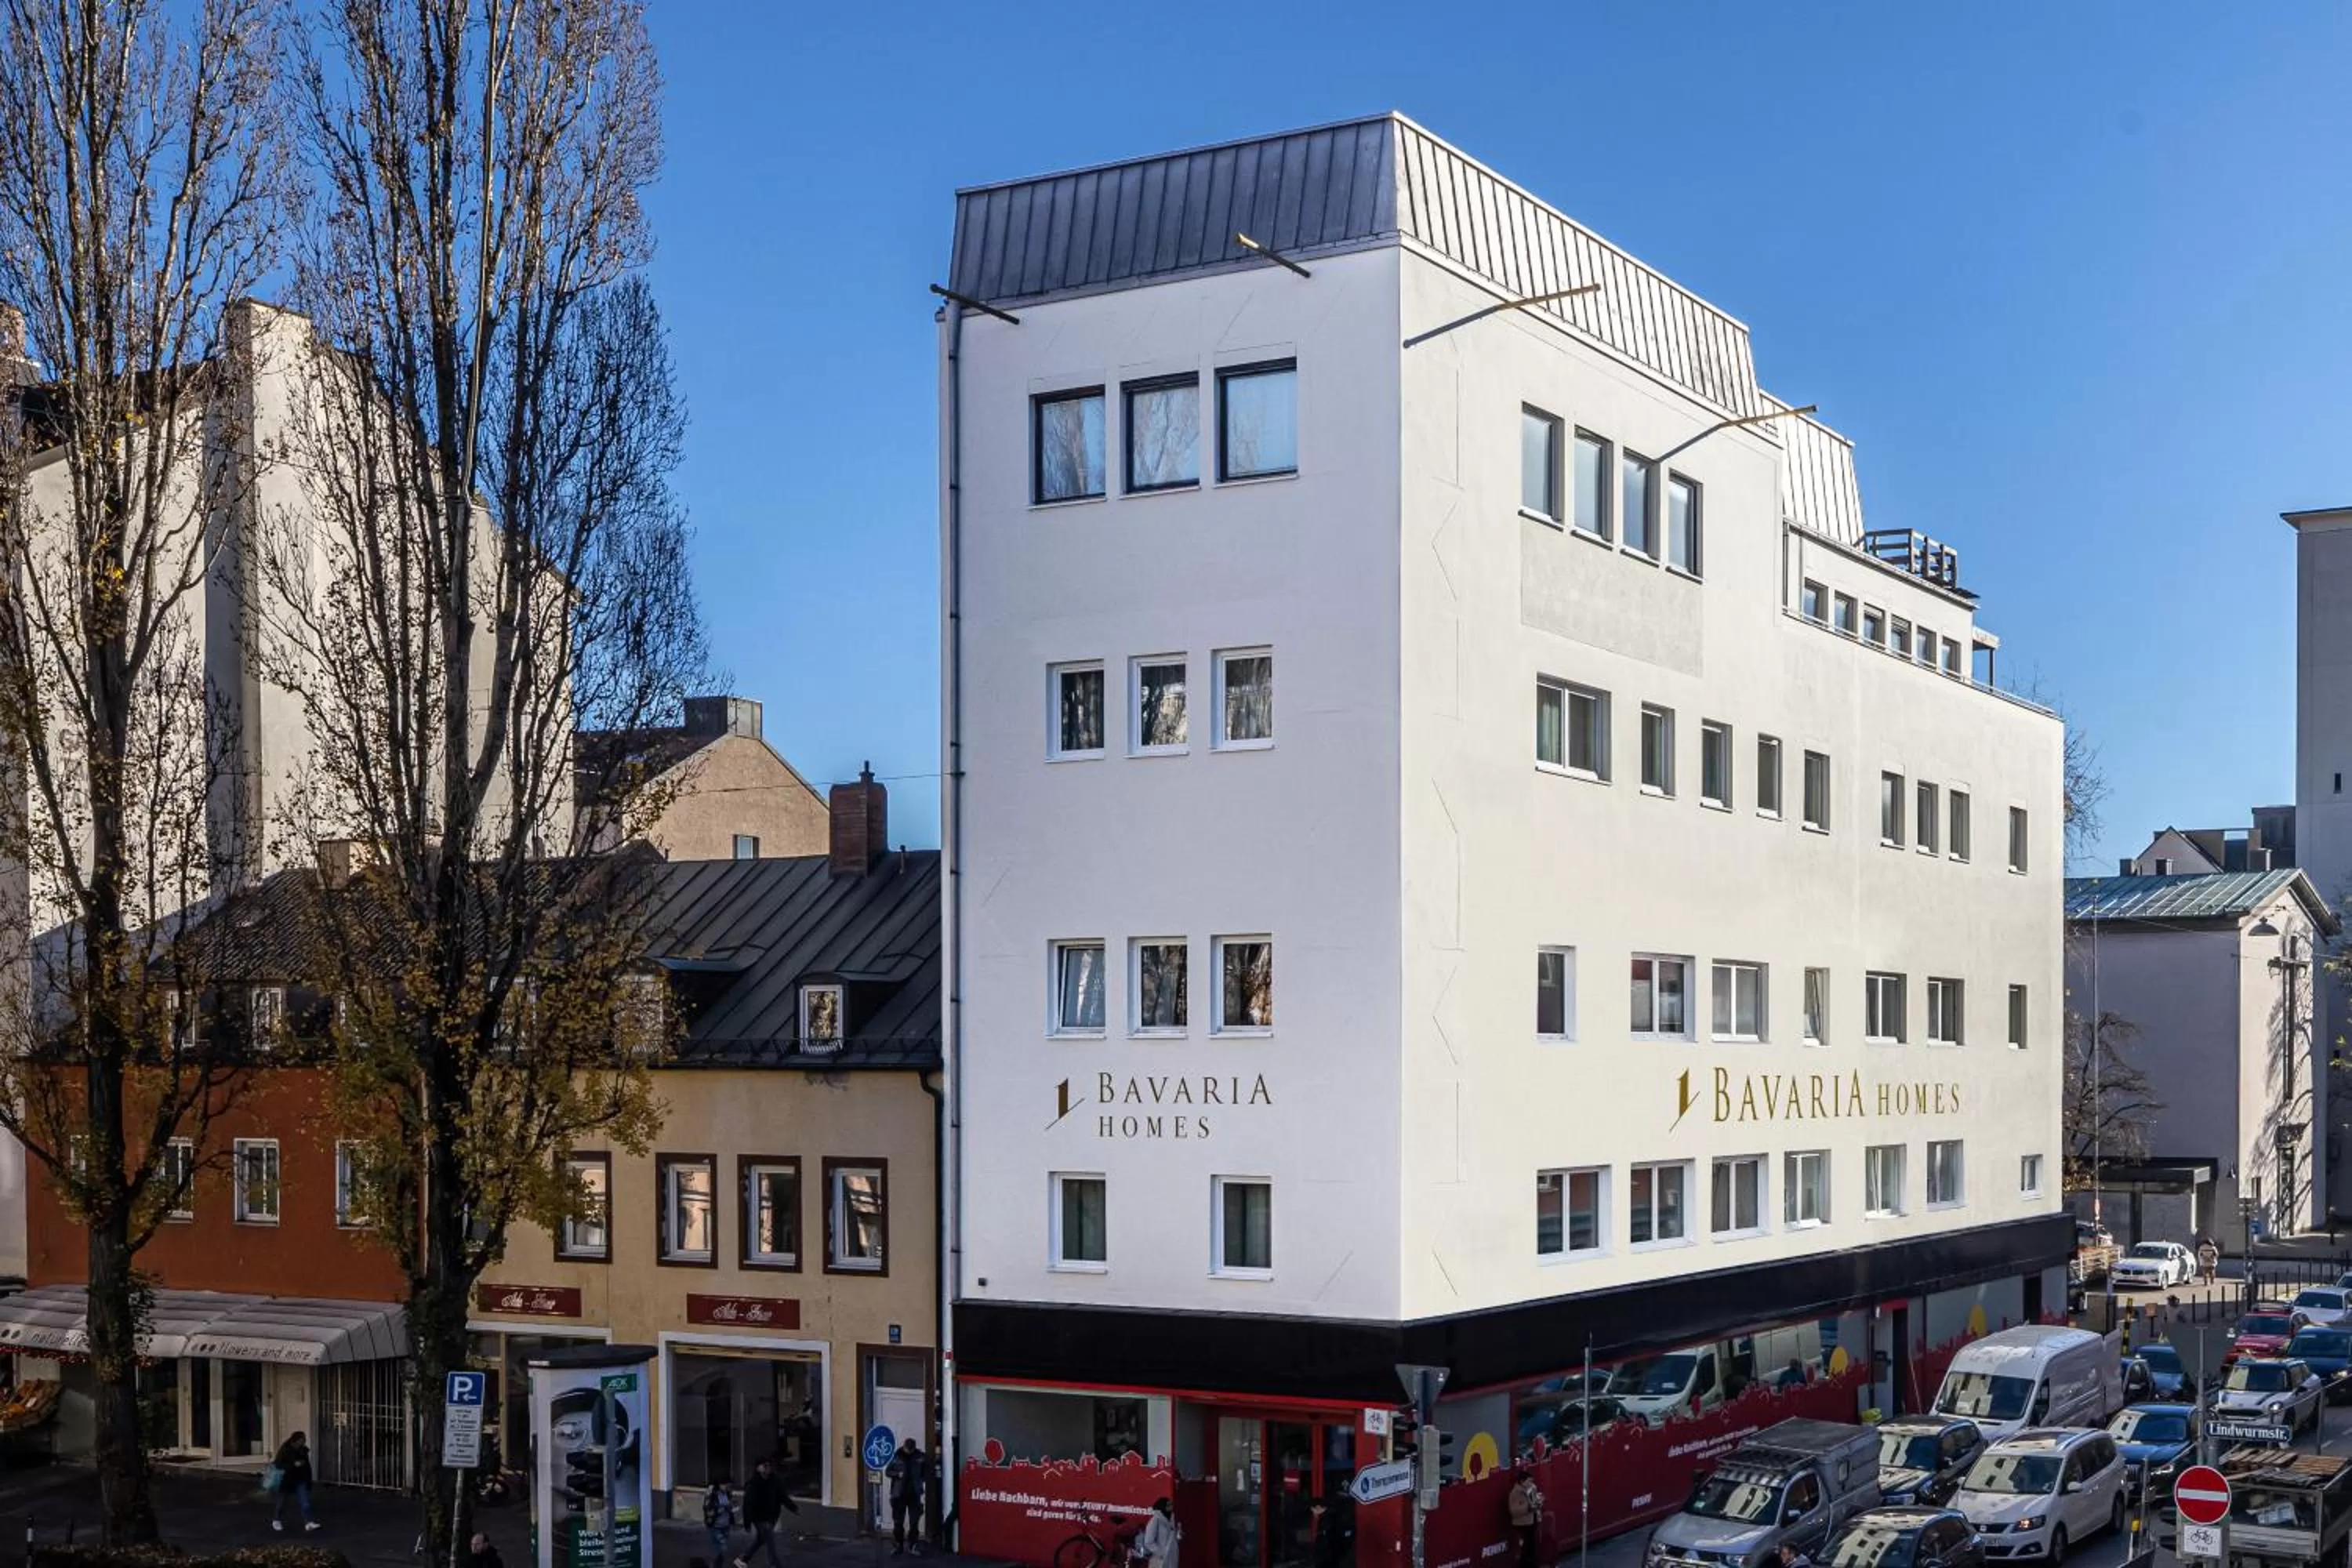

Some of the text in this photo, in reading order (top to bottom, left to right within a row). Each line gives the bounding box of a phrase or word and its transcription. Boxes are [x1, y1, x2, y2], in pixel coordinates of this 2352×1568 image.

[1098, 1072, 1272, 1105] BAVARIA
[1713, 1067, 1960, 1122] BAVARIA HOMES
[1098, 1115, 1210, 1138] HOMES
[452, 1376, 474, 1402] P
[2210, 1423, 2288, 1440] Lindwurmstr.
[971, 1488, 998, 1502] Liebe
[999, 1491, 1048, 1508] Nachbarn,
